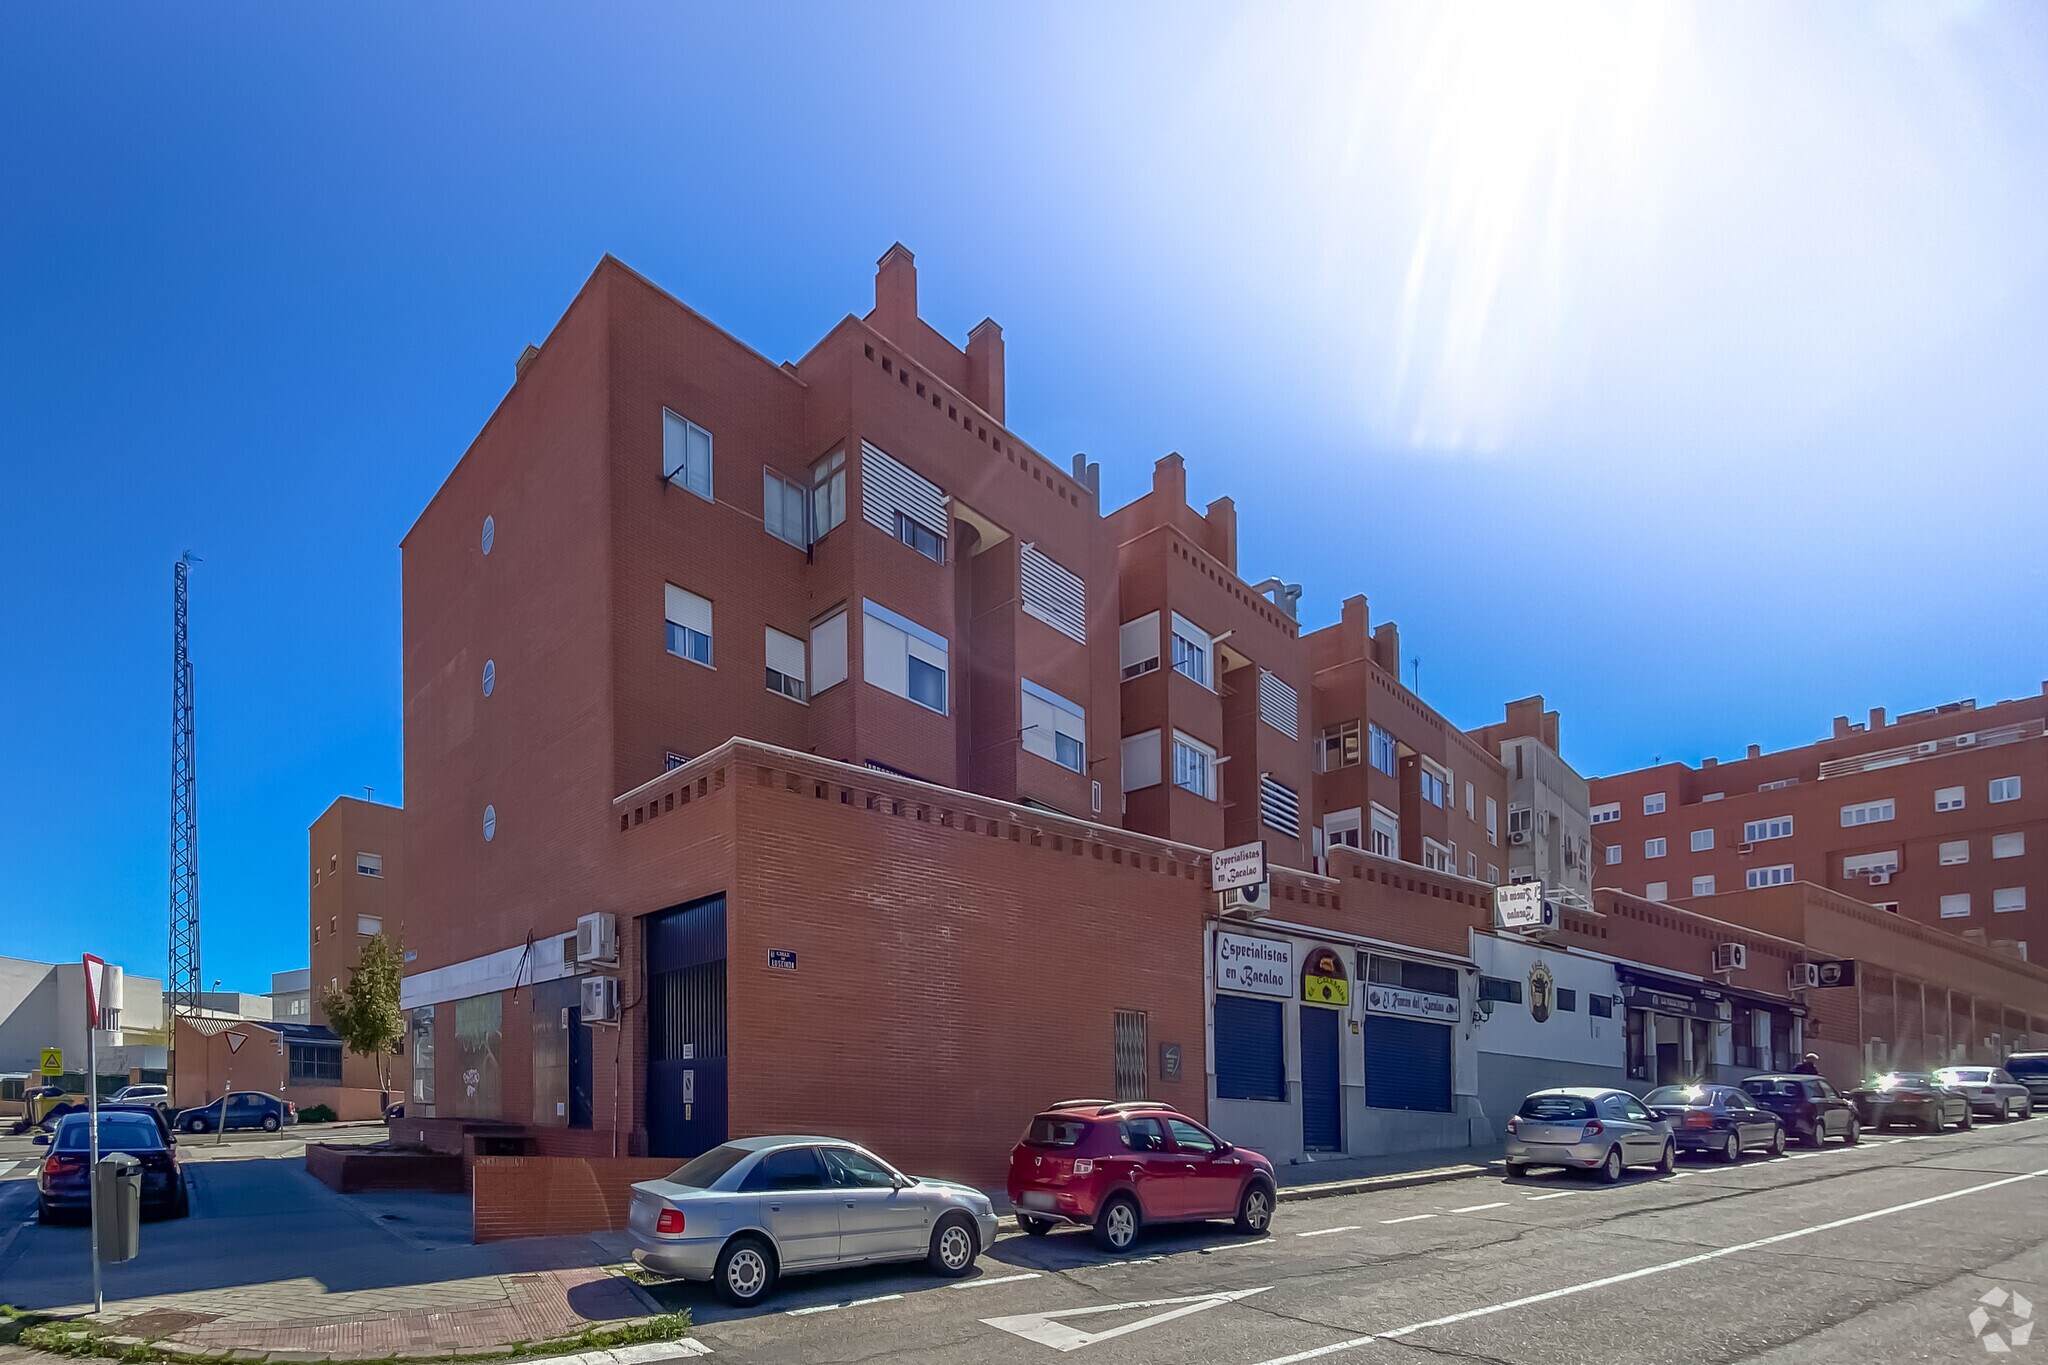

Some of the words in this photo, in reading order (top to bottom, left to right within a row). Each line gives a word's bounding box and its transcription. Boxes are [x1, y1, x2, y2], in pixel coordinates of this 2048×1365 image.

[1214, 850, 1260, 870] Especialistas
[1217, 874, 1225, 882] en
[1227, 865, 1256, 883] Bacalao
[1221, 938, 1288, 963] Especialistas
[1226, 967, 1237, 979] en
[1240, 965, 1284, 987] Bacalao
[1382, 990, 1390, 1009] El
[1412, 995, 1420, 1009] del
[1422, 997, 1444, 1015] Bacalao
